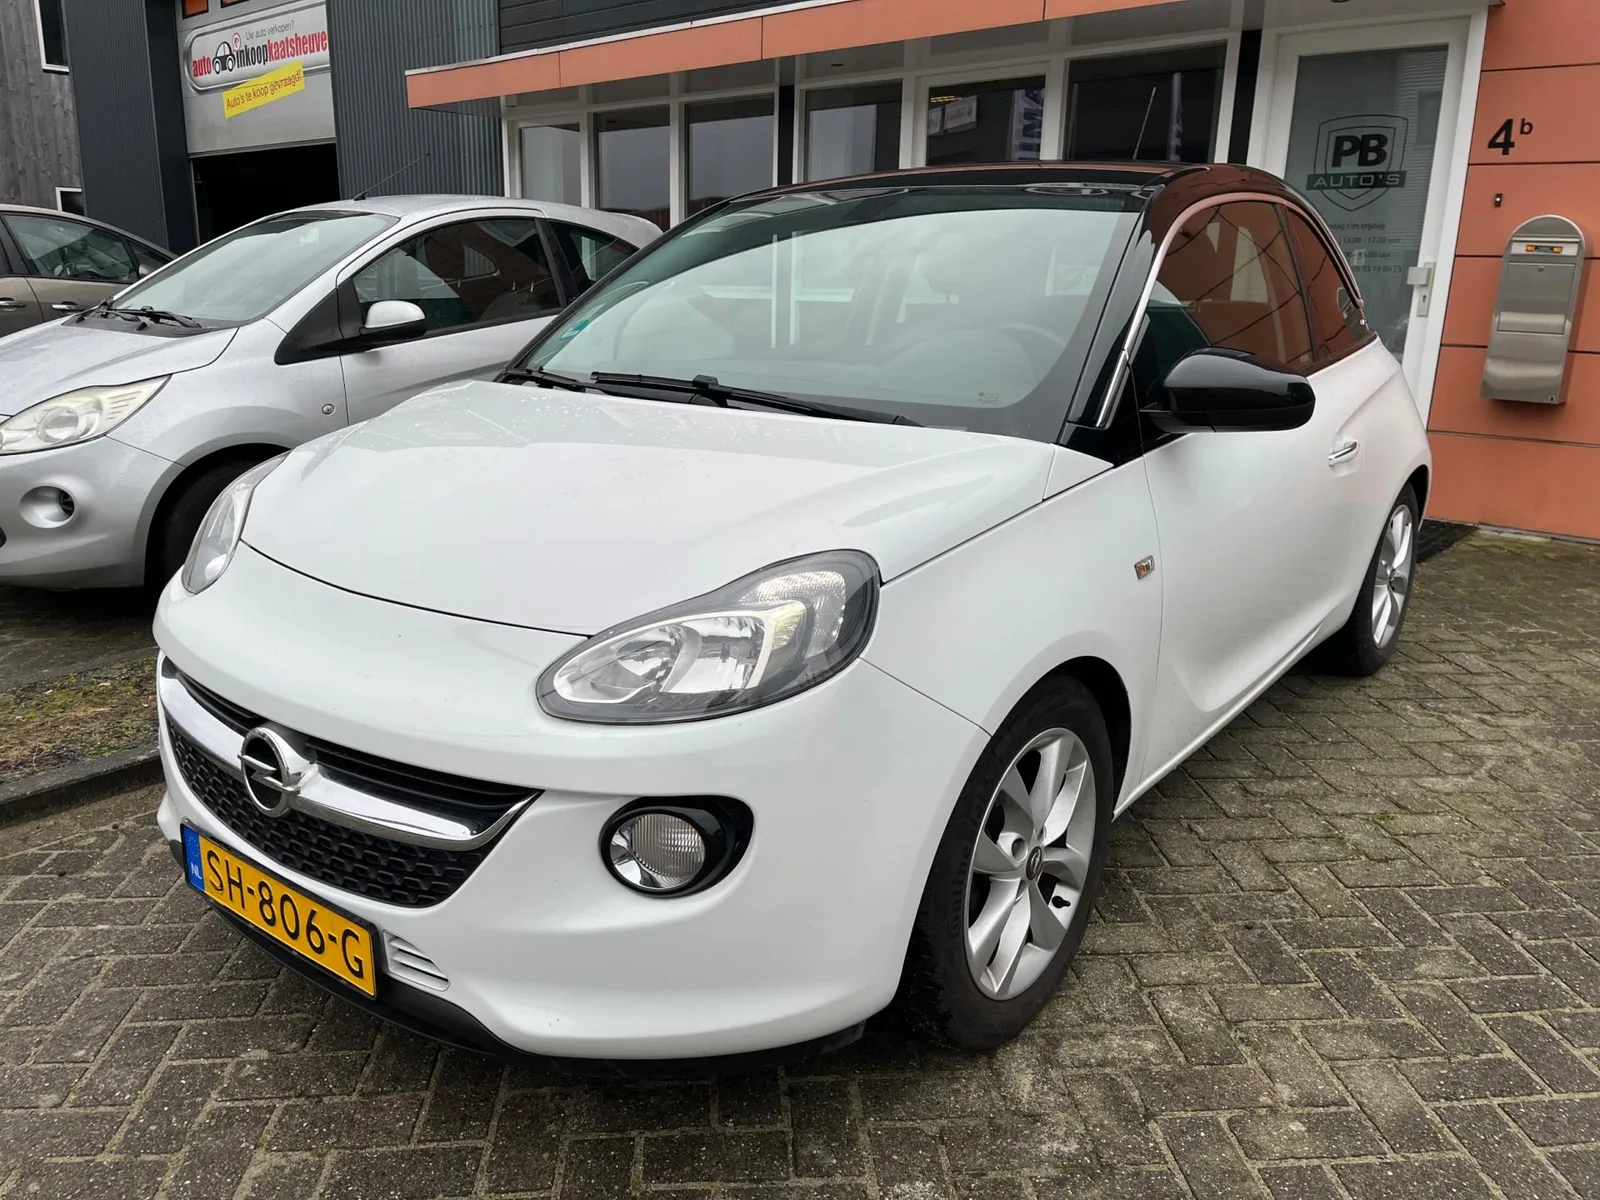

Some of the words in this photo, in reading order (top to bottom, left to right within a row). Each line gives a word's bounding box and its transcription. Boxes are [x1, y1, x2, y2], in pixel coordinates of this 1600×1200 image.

[246, 31, 254, 40] Uw
[255, 29, 267, 38] auto
[267, 20, 294, 35] verkopen?
[192, 55, 211, 77] auto
[226, 93, 245, 110] Auto's
[245, 91, 252, 102] te
[252, 85, 269, 99] koop
[1331, 133, 1389, 168] PB
[1312, 173, 1400, 188] AUTO'S
[191, 862, 202, 880] NL
[206, 850, 364, 979] SH-806-G
